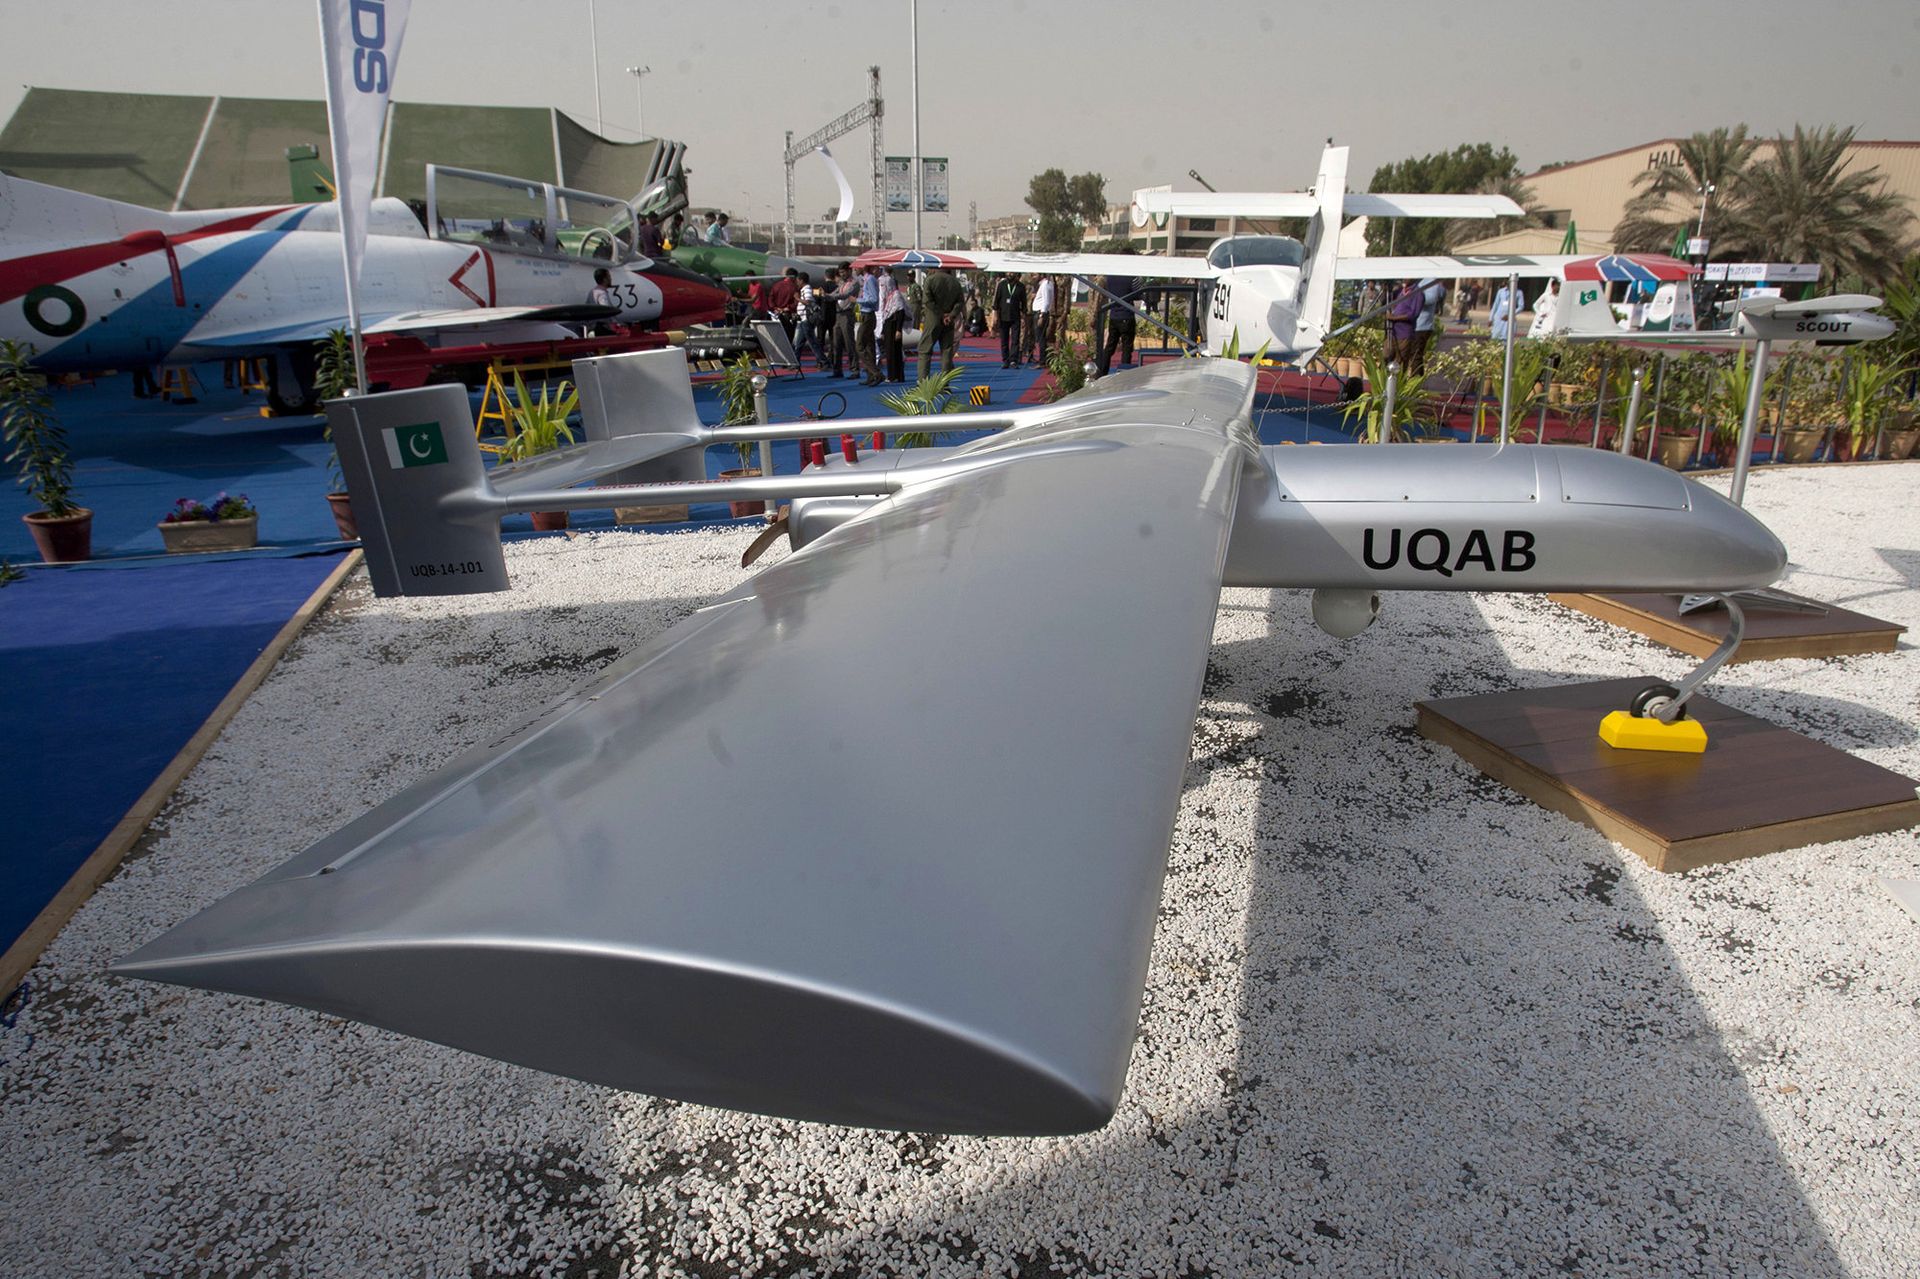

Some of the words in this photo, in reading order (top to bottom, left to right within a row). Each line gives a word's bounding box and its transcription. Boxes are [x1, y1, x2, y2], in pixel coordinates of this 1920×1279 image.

[350, 0, 388, 94] DS
[1647, 150, 1685, 170] HALL
[1213, 283, 1231, 322] 391
[1795, 321, 1852, 332] SCOUT
[1363, 528, 1537, 577] UQAB
[410, 561, 484, 577] UQB-14-101
